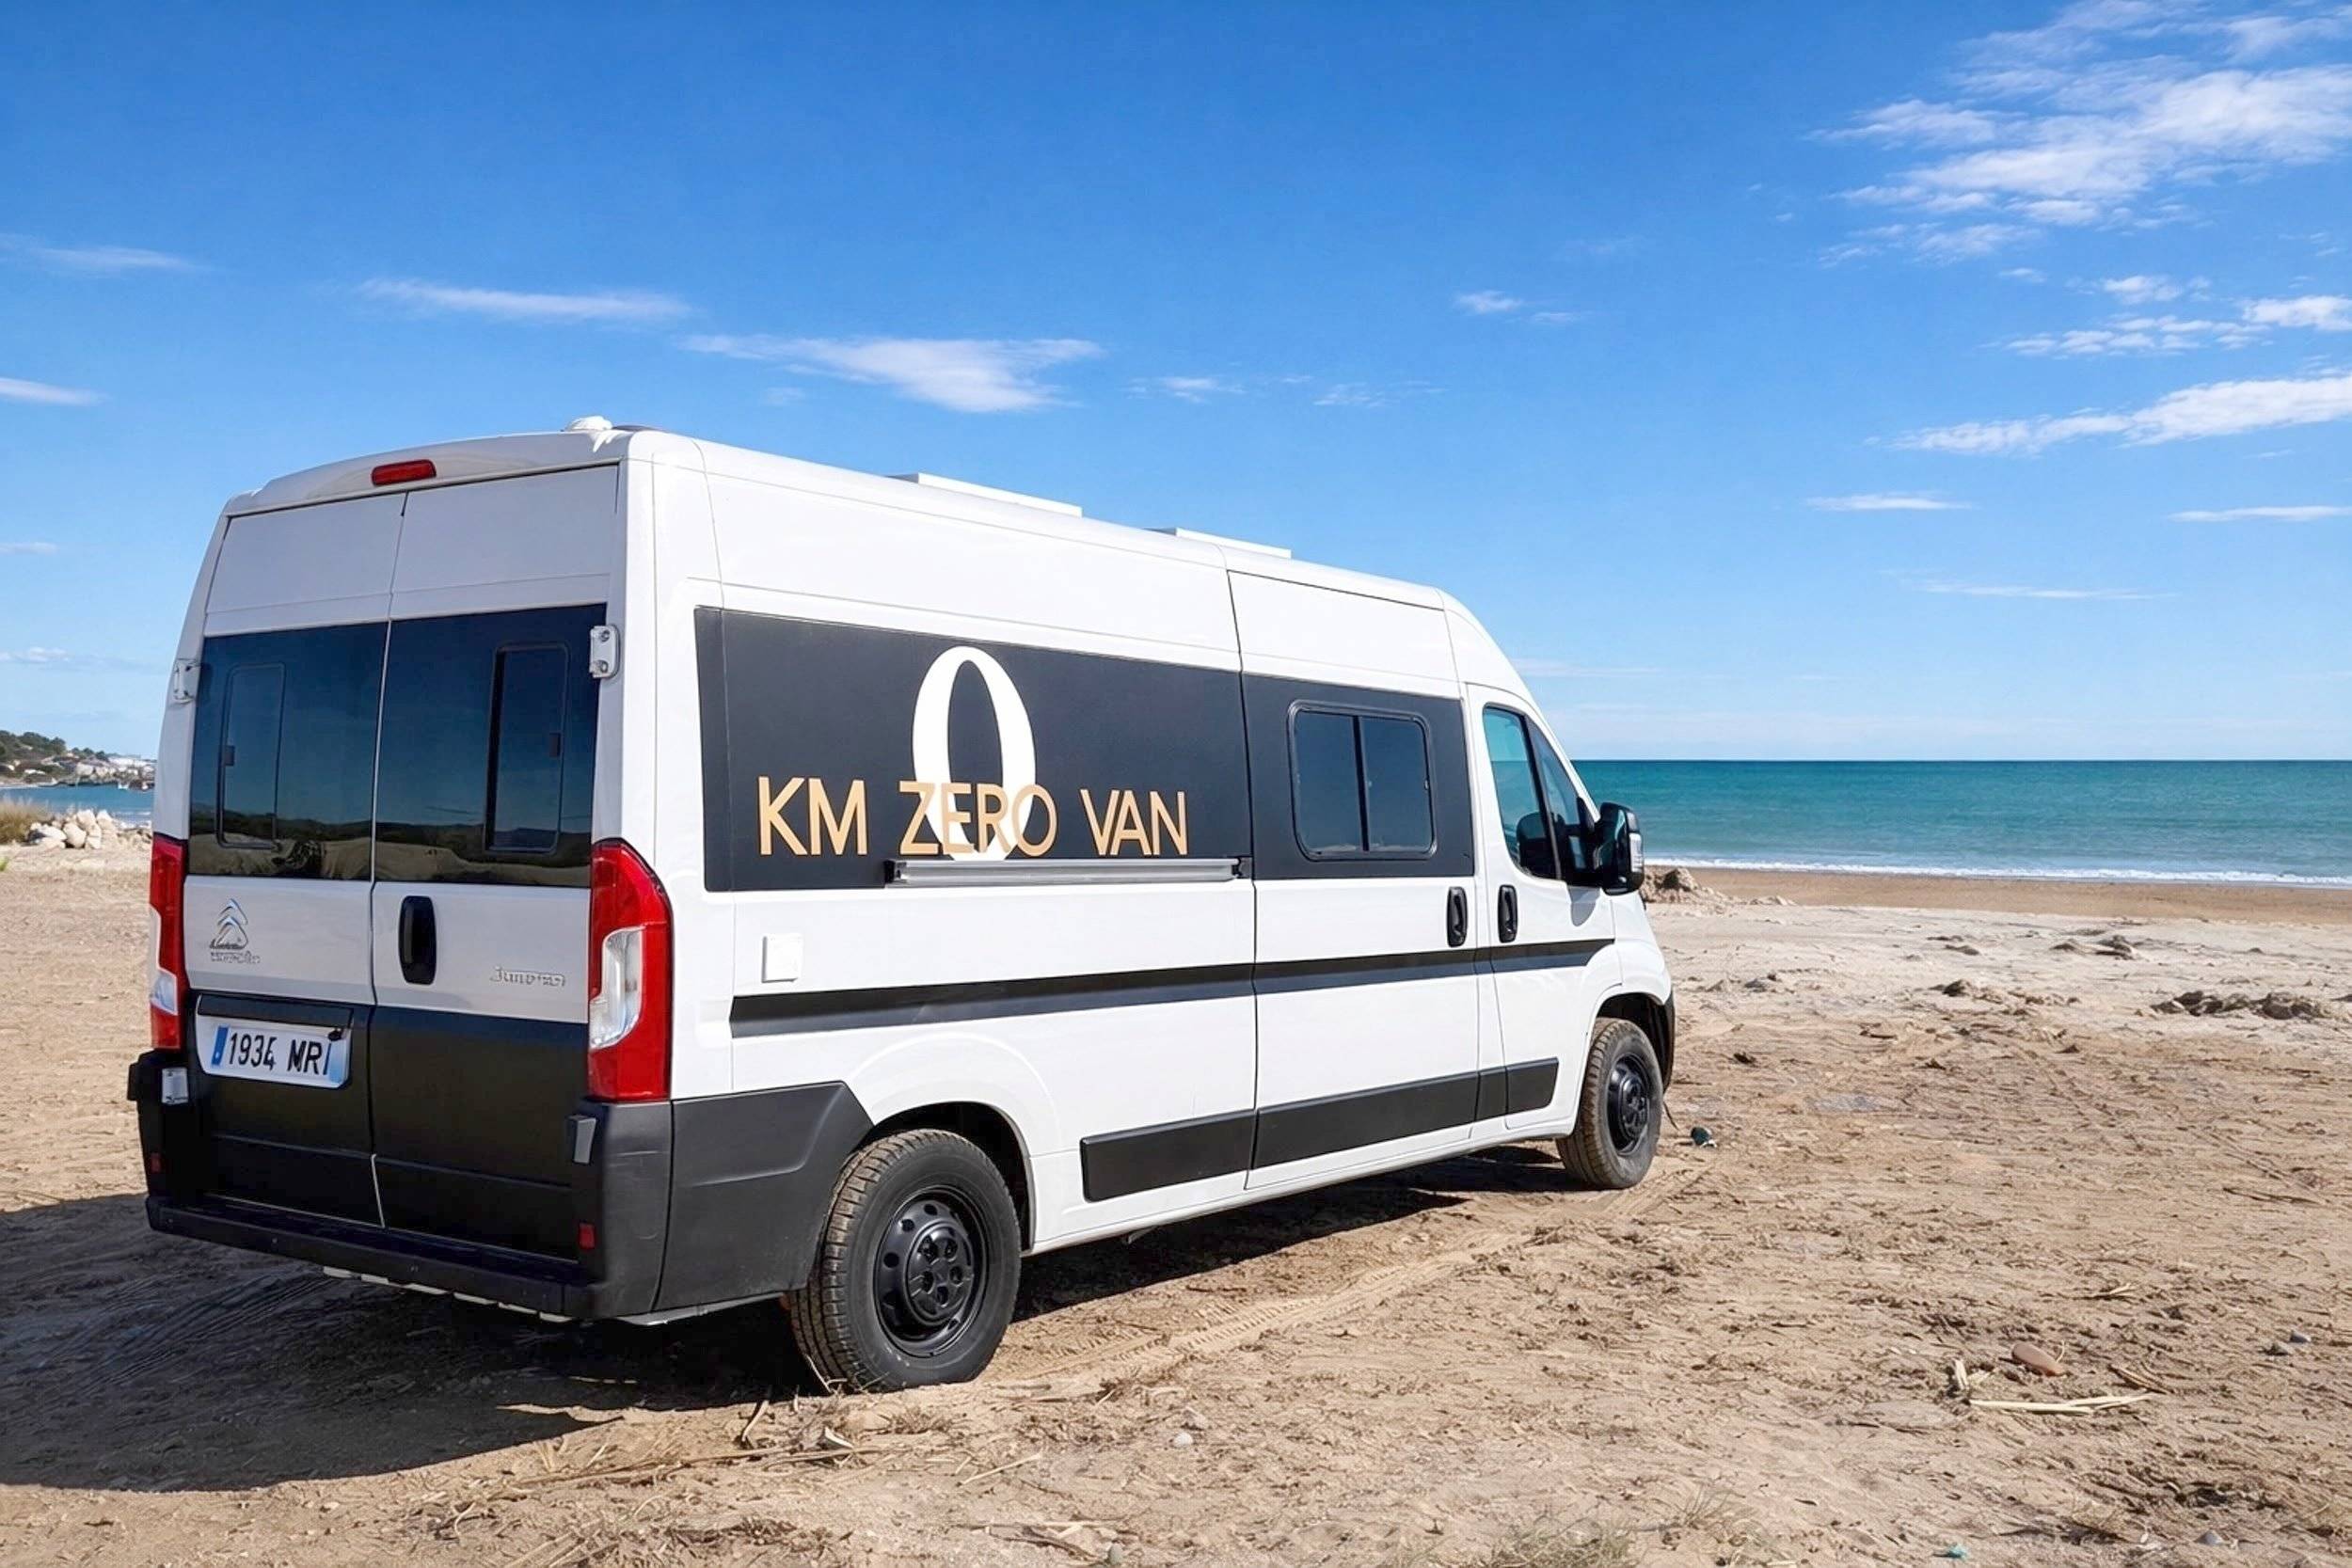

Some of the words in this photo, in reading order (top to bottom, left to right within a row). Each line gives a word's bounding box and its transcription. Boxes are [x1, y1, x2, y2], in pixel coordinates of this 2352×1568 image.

[758, 776, 867, 855] KM
[898, 781, 1058, 856] ZERO
[1080, 789, 1187, 855] VAN
